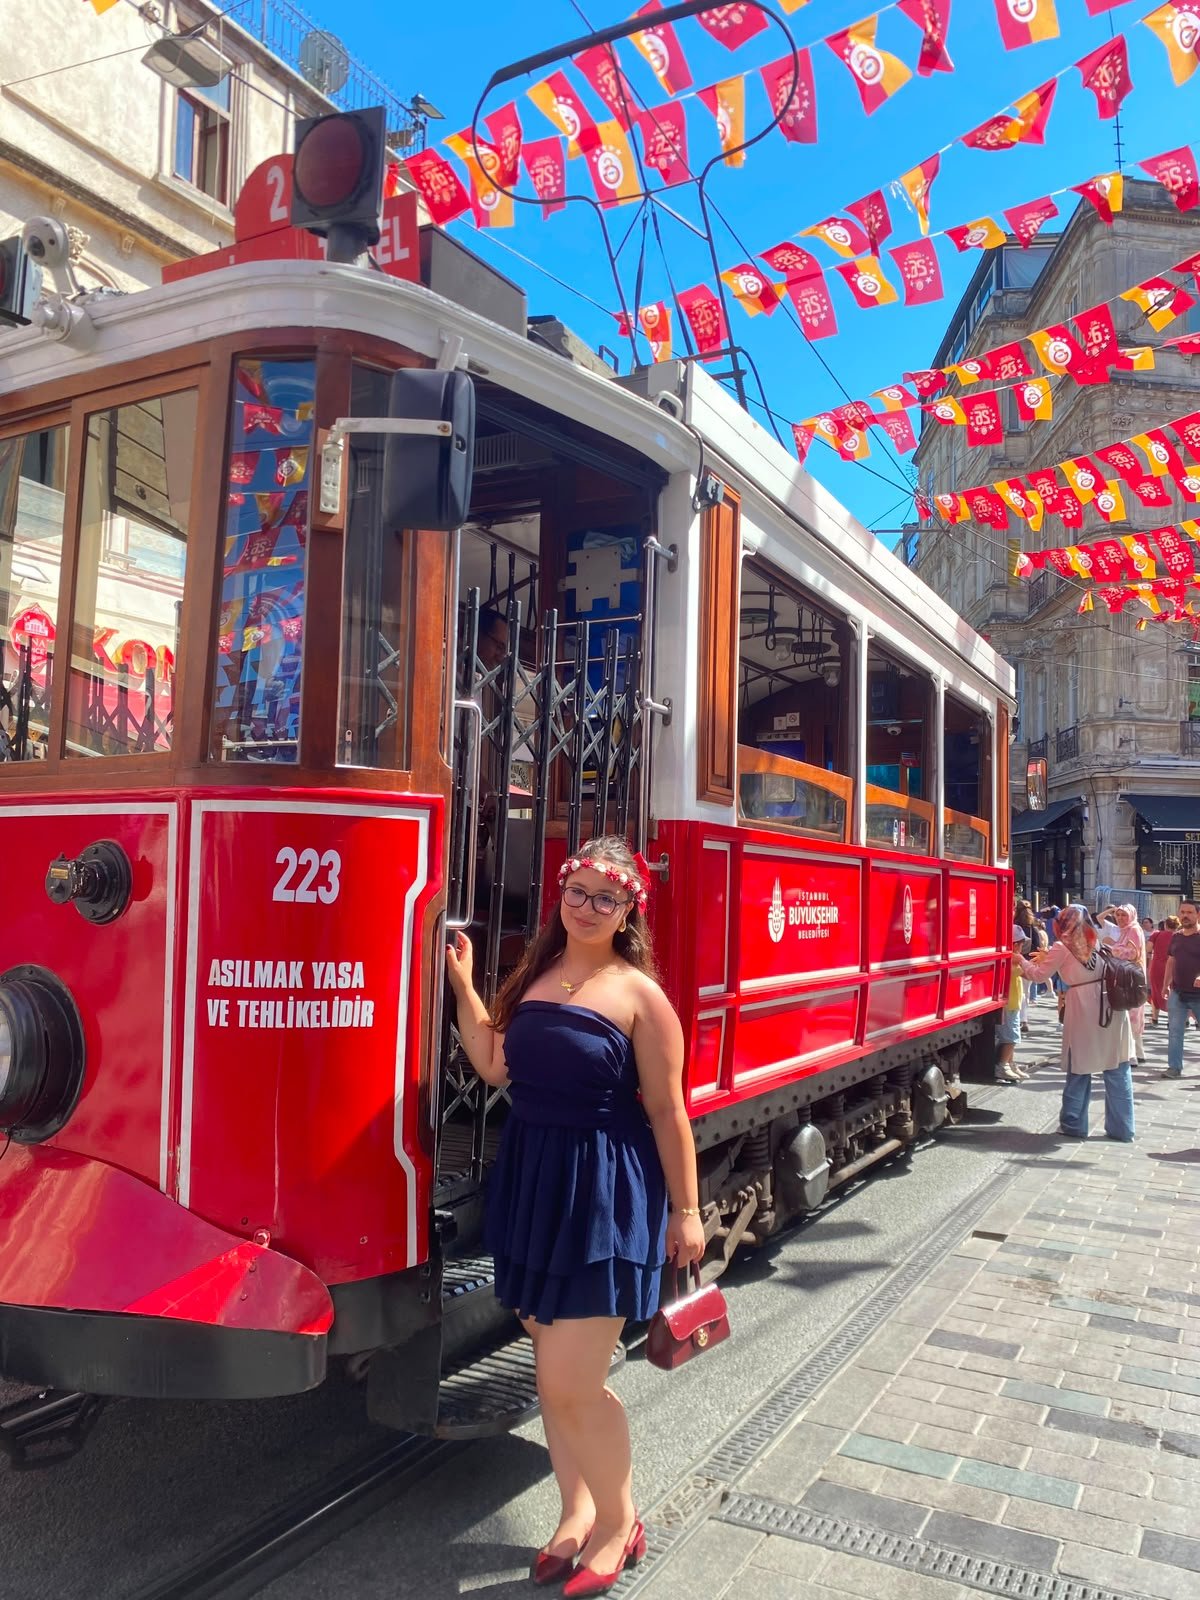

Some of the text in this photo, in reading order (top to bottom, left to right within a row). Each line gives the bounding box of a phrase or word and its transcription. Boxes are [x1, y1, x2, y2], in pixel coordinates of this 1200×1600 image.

[272, 846, 342, 904] 223
[789, 901, 839, 929] BÜYÜKŞEHİR
[798, 926, 831, 940] BELEDİYESİ
[207, 958, 365, 989] ASILMAK YASA
[206, 994, 375, 1029] VE TEHLİKELİDİR
